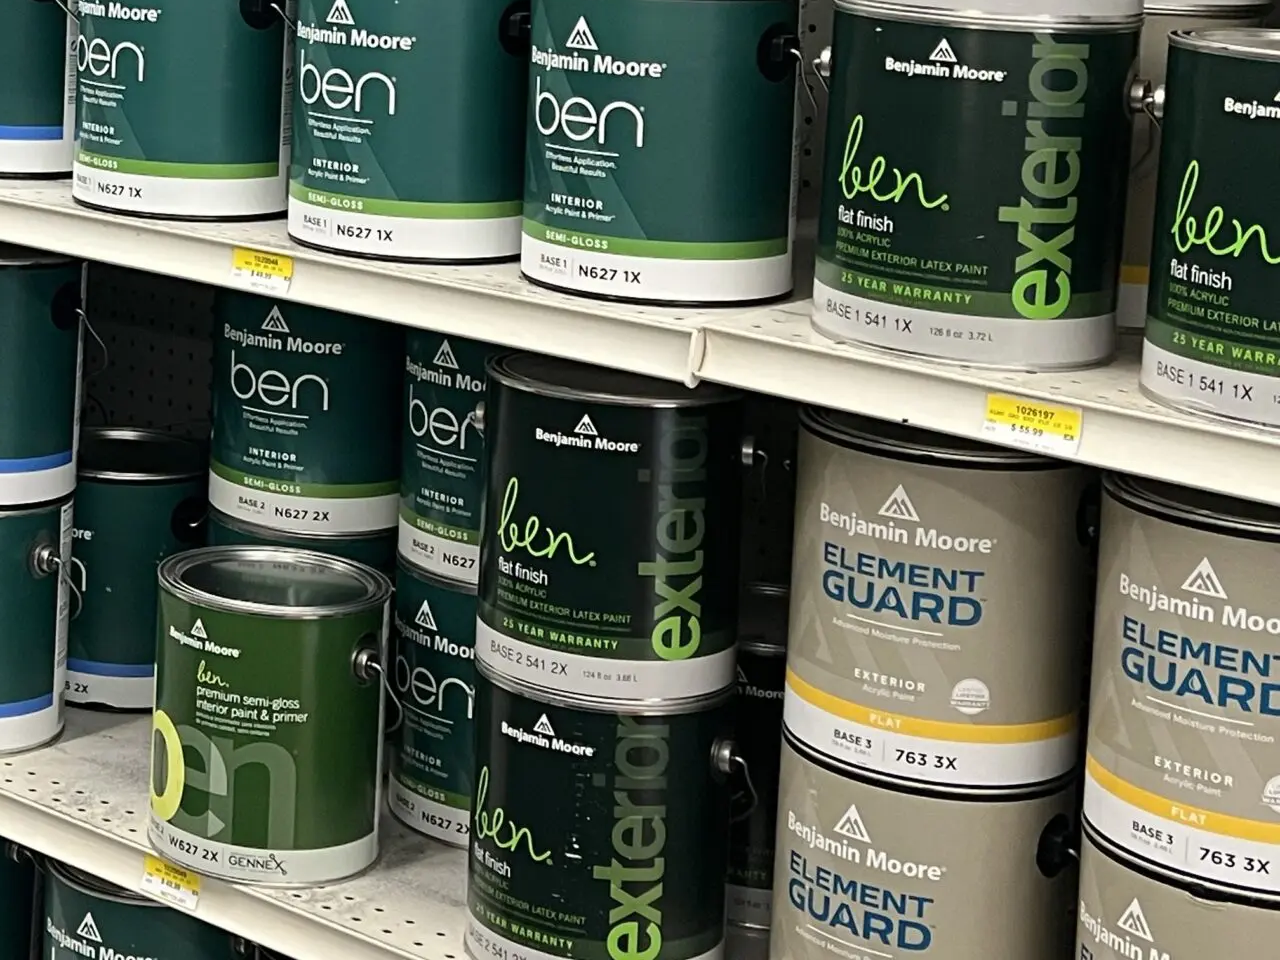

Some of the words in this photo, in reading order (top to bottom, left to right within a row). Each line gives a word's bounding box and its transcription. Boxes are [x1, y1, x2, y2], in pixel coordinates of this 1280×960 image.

[531, 45, 588, 72] Benjamin
[593, 54, 663, 78] Moore
[885, 57, 949, 78] Benjamin
[953, 65, 1003, 82] Moore
[998, 33, 1089, 320] exterior
[337, 223, 371, 239] N627
[377, 229, 393, 242] 1X
[838, 204, 854, 224] flat
[856, 209, 893, 233] finish
[545, 230, 609, 250] SEMI-GLOSS
[540, 253, 561, 267] BASE
[578, 265, 617, 281] N627
[623, 270, 641, 284] 1X
[872, 251, 917, 267] EXTERIOR
[921, 259, 952, 272] LATEX
[955, 264, 988, 275] PAINT
[1157, 361, 1184, 386] BASE
[1199, 375, 1223, 396] 541
[1232, 383, 1253, 402] 1X
[1016, 406, 1055, 419] 1026197
[536, 428, 592, 450] Benjamin
[595, 437, 638, 453] Moore
[244, 477, 301, 494] SEMI-GLOSS
[238, 496, 258, 510] BASE
[275, 506, 308, 520] N627
[313, 510, 330, 522] 2X
[638, 409, 709, 661] exterior
[820, 502, 908, 544] Benjamin
[915, 527, 992, 554] Moore
[824, 541, 985, 592] ELEMENT
[822, 569, 982, 627] GUARD
[491, 640, 514, 662] BASE
[526, 654, 545, 671] 541
[551, 661, 568, 677] 2X
[854, 667, 926, 693] EXTERIOR
[196, 686, 241, 707] premium
[243, 693, 300, 712] semi-gloss
[196, 698, 229, 715] interior
[231, 705, 258, 721] paint
[260, 710, 269, 721] &
[272, 710, 309, 725] primer
[870, 712, 902, 729] FLAT
[834, 729, 863, 747] BASE
[895, 749, 928, 767] 763
[934, 754, 957, 771] 3X
[169, 834, 198, 856] W627
[202, 847, 219, 863] 2X
[1132, 820, 1165, 844] BASE
[1199, 847, 1236, 869] 763
[1243, 856, 1271, 875] 3X
[228, 853, 287, 875] GENNEX
